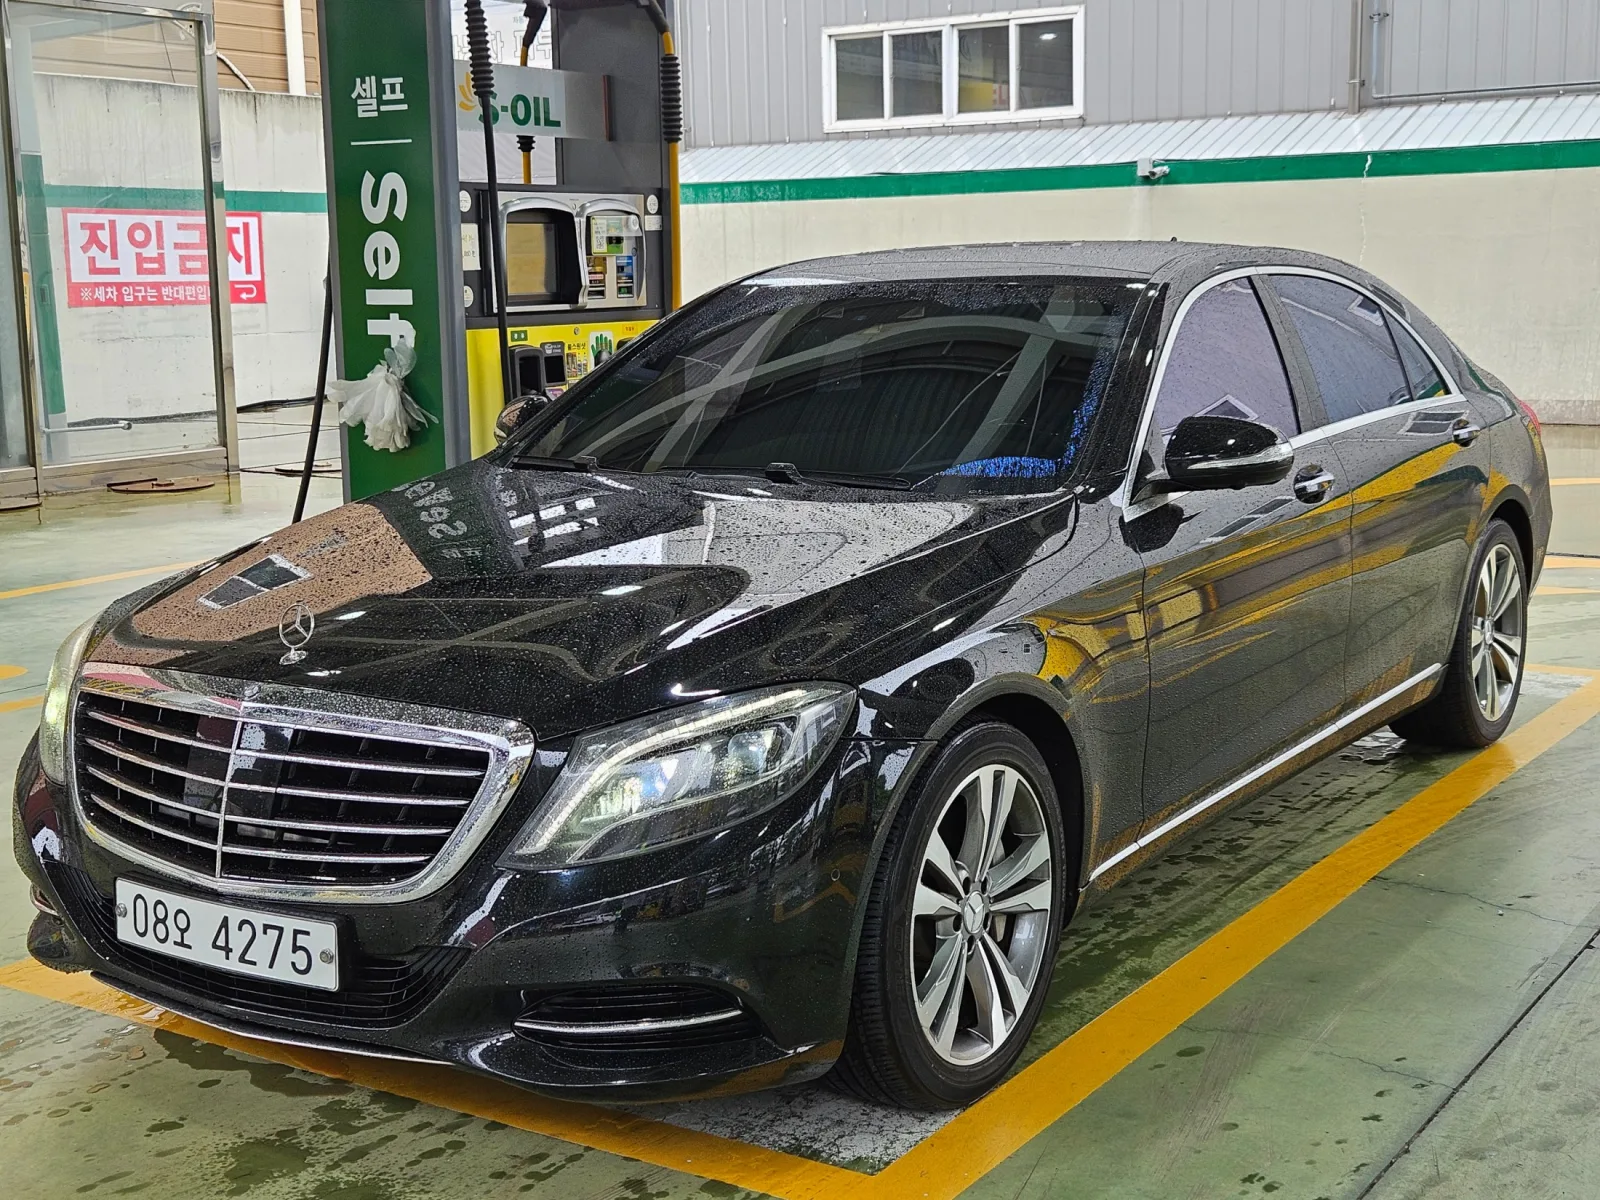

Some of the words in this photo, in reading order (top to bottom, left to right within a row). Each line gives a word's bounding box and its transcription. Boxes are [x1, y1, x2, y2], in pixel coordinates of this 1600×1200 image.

[351, 75, 408, 118] 셀프
[80, 219, 253, 275] 진입금지
[361, 170, 416, 348] Self
[123, 286, 158, 301] 입구는
[132, 893, 193, 950] 08오
[211, 915, 313, 976] 4275
